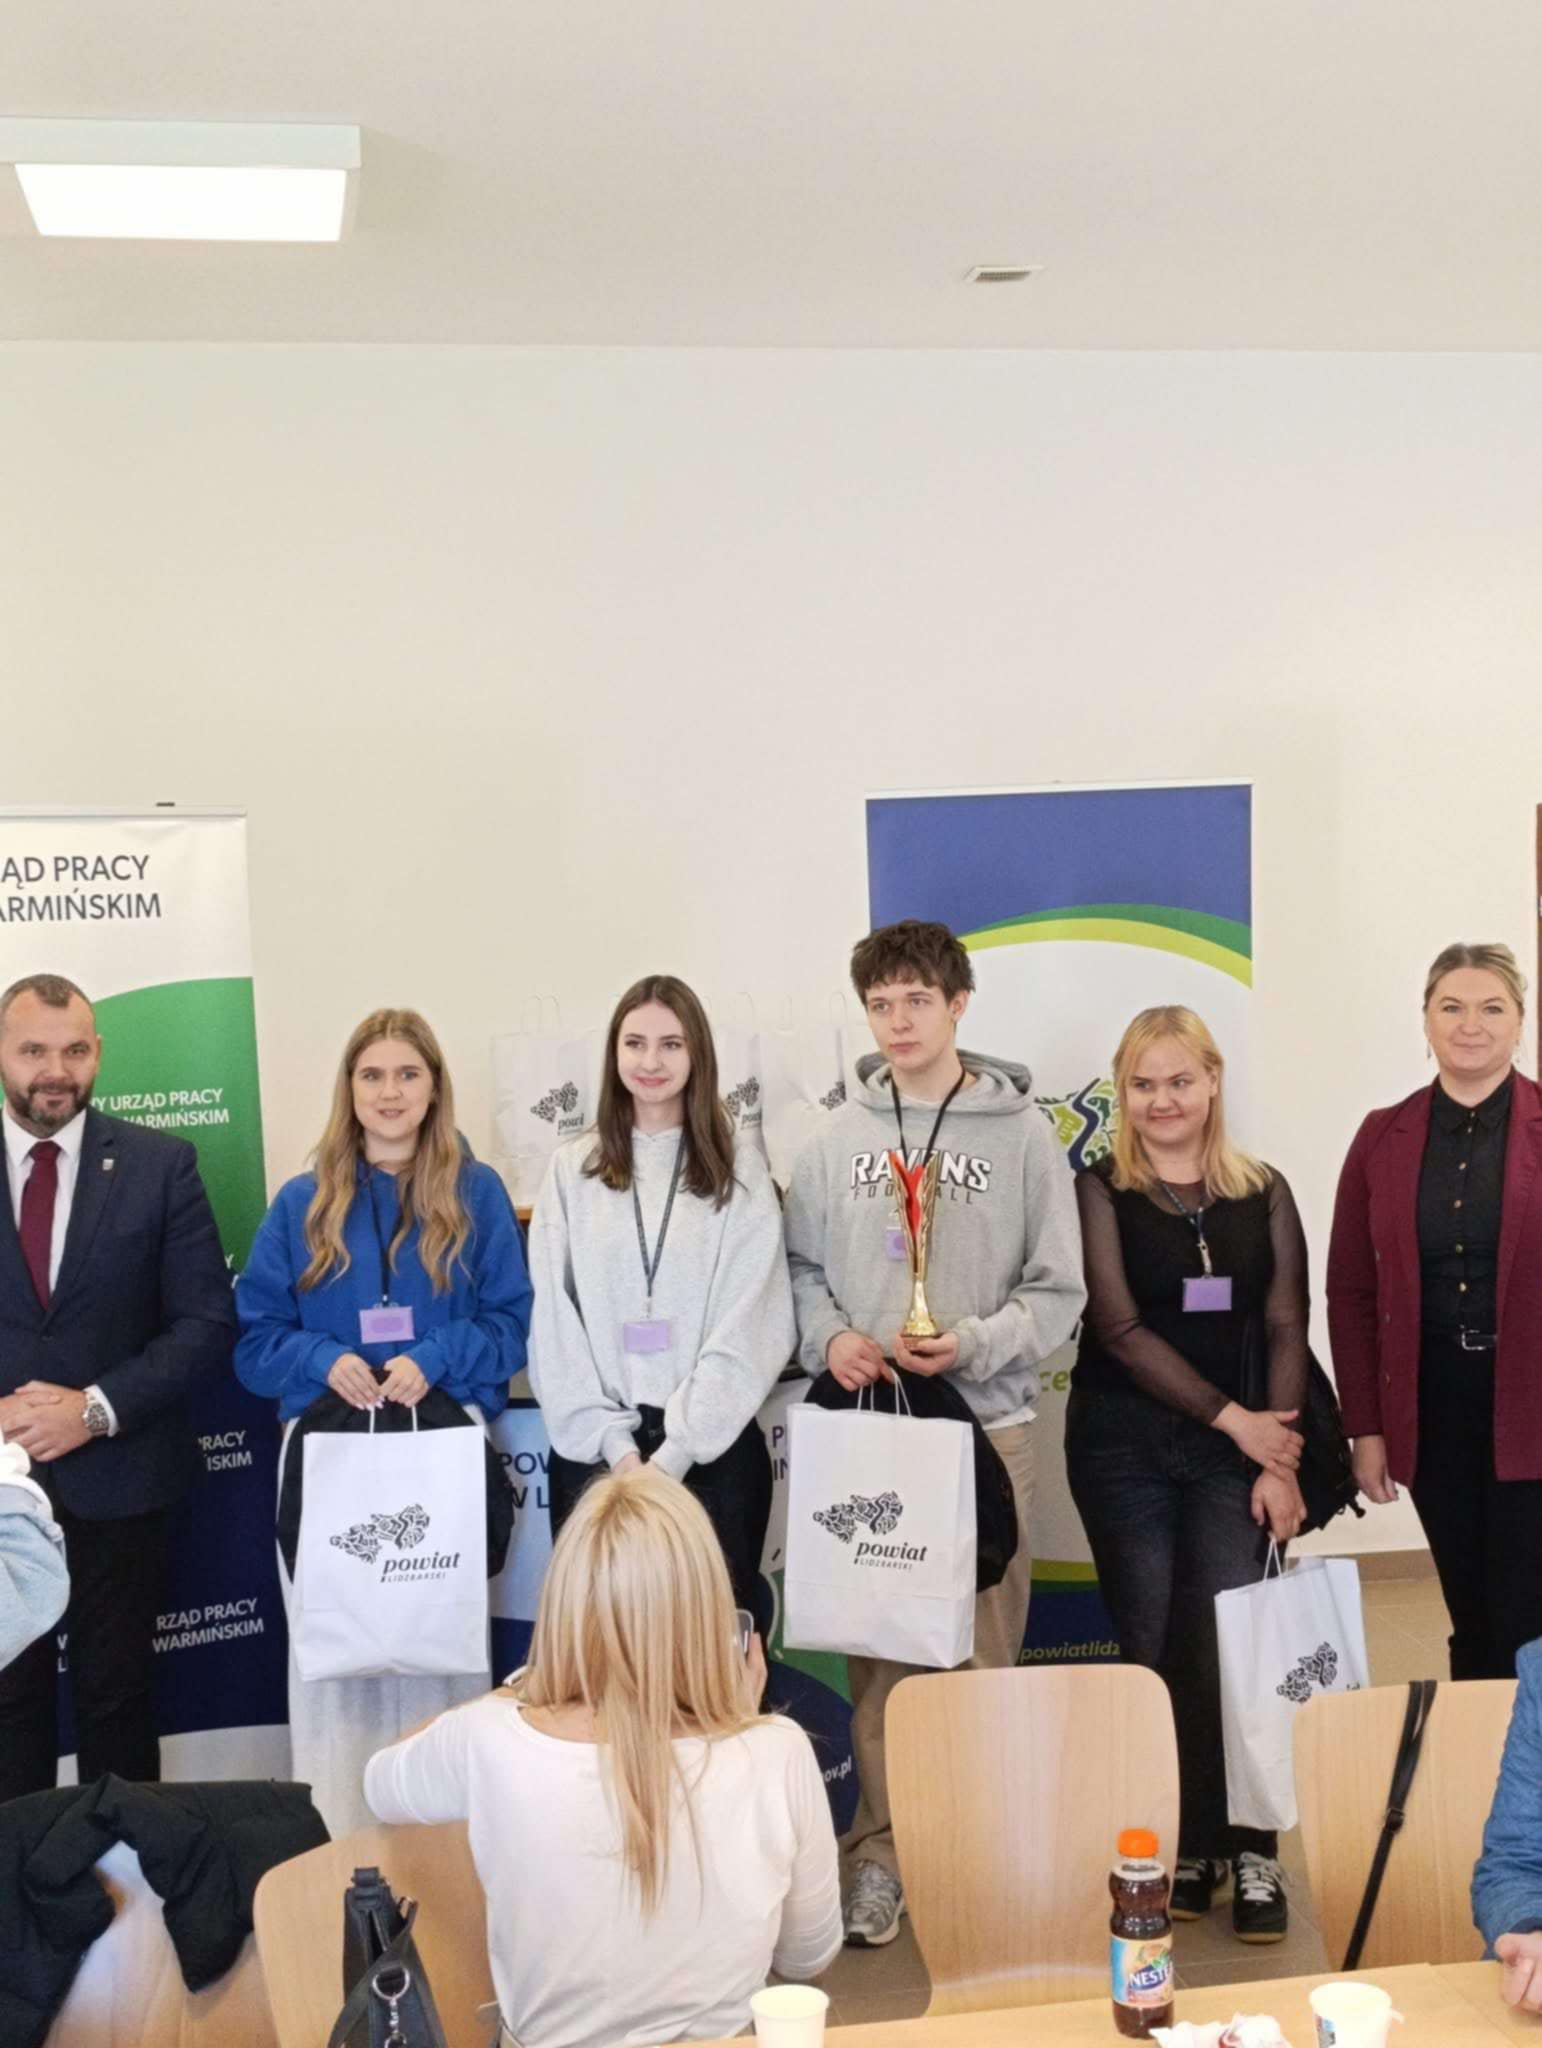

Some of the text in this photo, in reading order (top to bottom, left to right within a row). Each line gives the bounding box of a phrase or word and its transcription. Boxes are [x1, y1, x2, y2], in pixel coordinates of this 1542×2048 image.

[54, 855, 149, 882] PRACY
[110, 1093, 166, 1112] URZĄD
[169, 1088, 223, 1106] PRACY
[383, 1552, 460, 1575] powiat
[857, 1542, 927, 1562] powiat
[156, 1597, 257, 1631] RZĄD PRACY
[152, 1618, 264, 1654] WARMIŃSKIM
